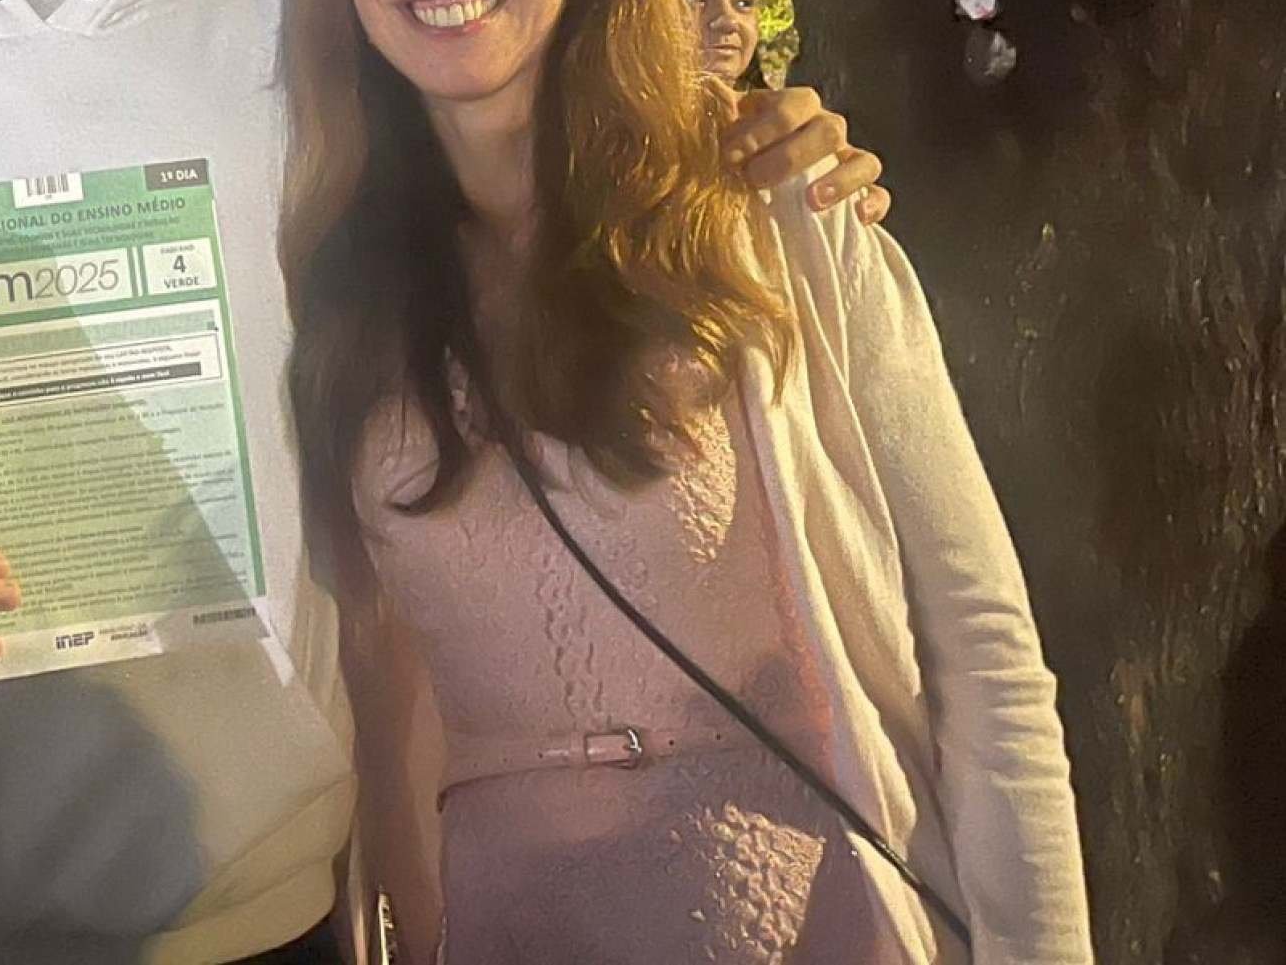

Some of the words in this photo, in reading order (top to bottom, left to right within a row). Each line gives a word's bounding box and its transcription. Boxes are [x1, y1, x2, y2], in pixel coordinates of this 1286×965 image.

[175, 167, 199, 182] DIA
[51, 209, 73, 225] DO
[77, 203, 133, 222] ENSINO
[137, 195, 186, 214] MÉDIO
[173, 254, 187, 273] 4
[163, 275, 200, 289] VERDE
